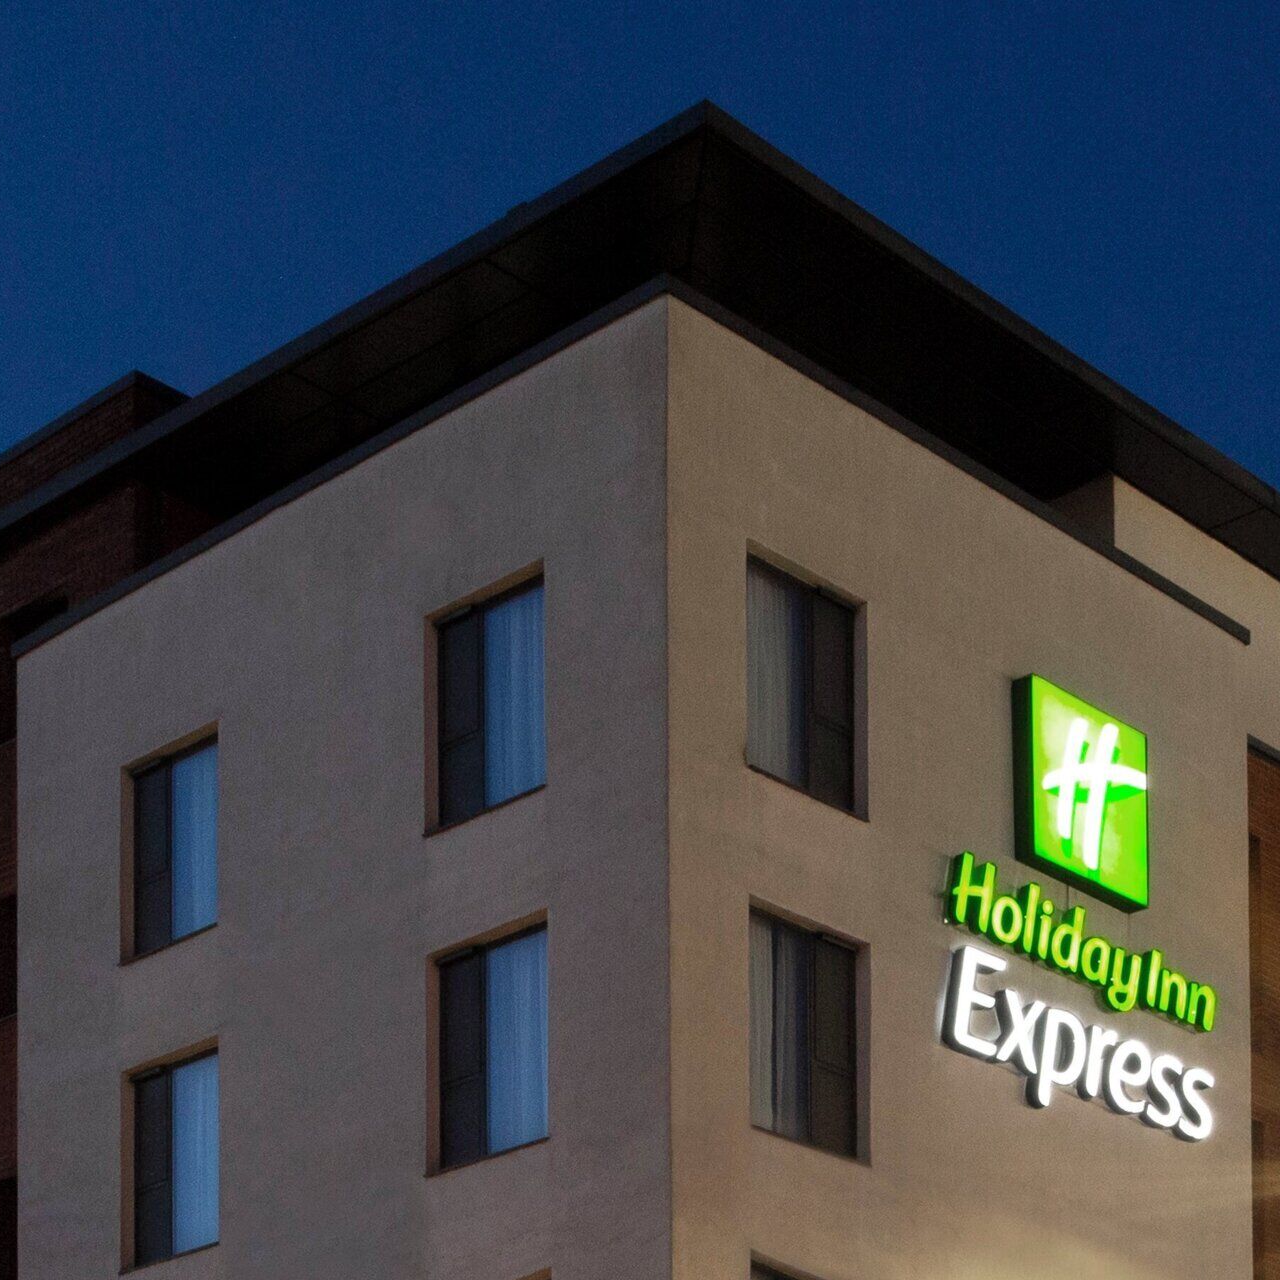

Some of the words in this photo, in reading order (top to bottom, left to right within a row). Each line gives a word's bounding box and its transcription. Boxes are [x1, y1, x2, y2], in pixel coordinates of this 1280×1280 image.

[950, 851, 1142, 1013] Holiday
[1146, 949, 1217, 1032] Inn
[950, 945, 1216, 1141] Express
